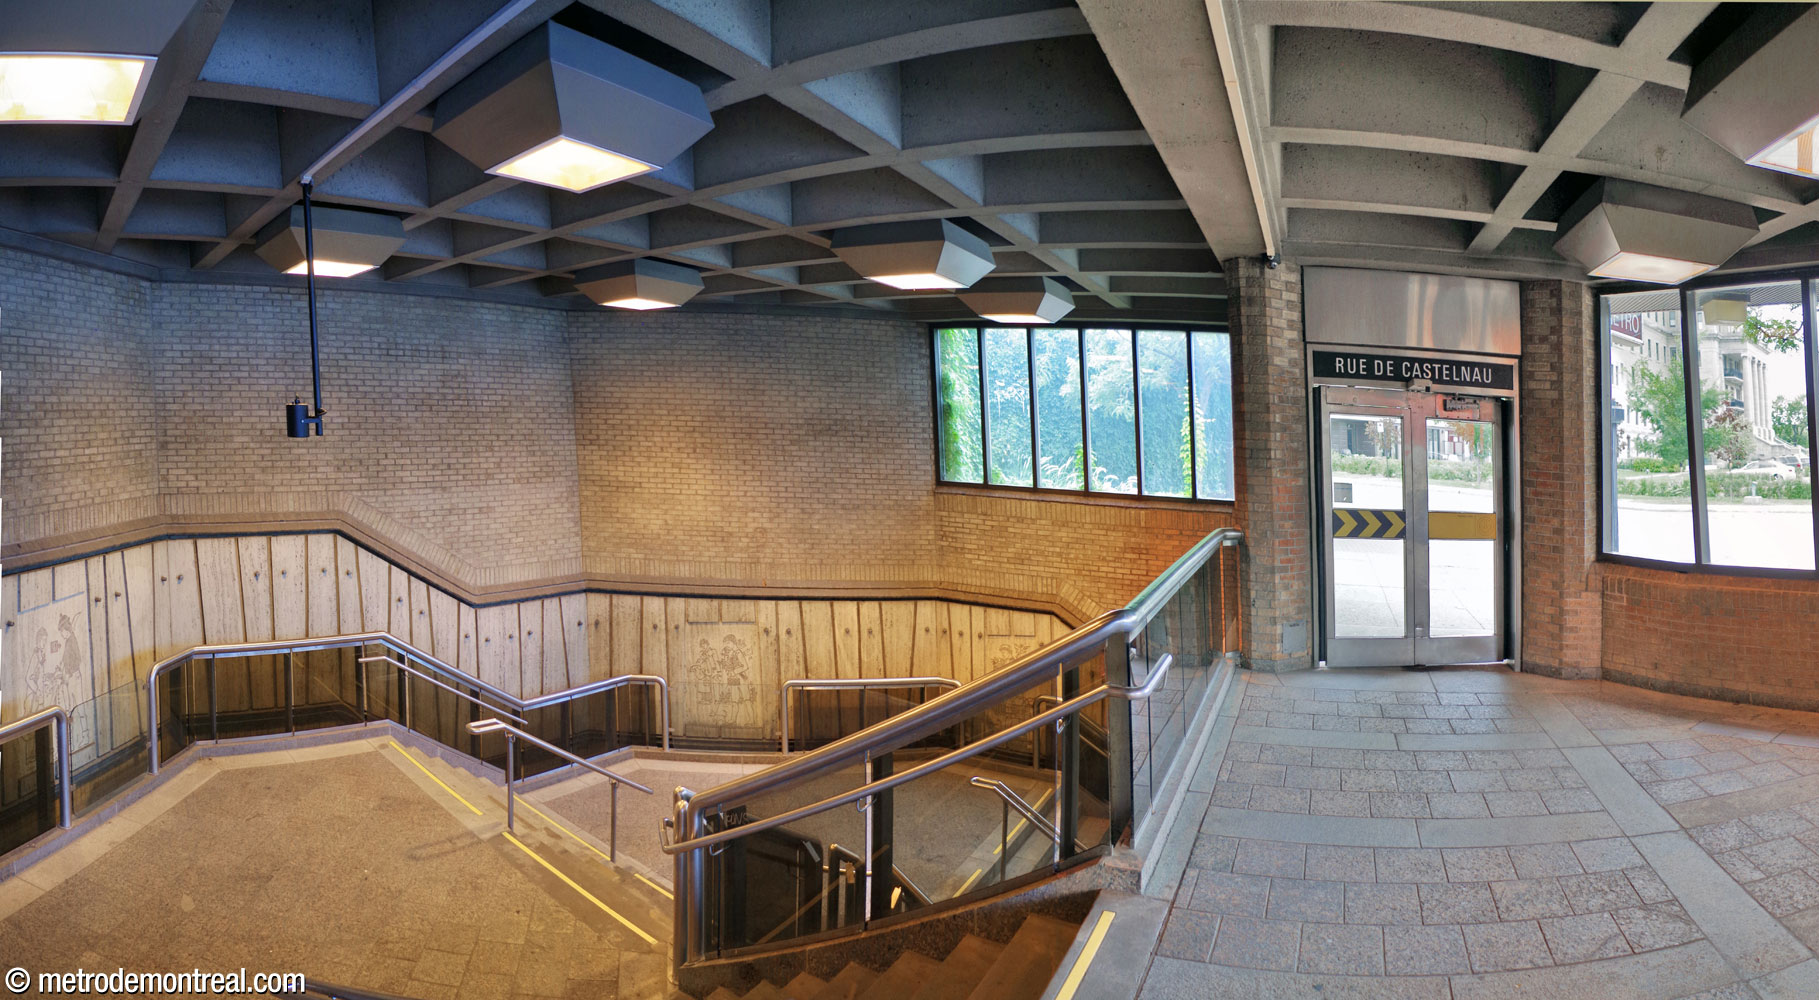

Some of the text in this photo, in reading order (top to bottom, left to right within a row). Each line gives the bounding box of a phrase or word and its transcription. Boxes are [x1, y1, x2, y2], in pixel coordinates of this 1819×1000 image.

[1610, 313, 1640, 333] ETRO
[1335, 357, 1492, 384] RUE DE CASTELNAU
